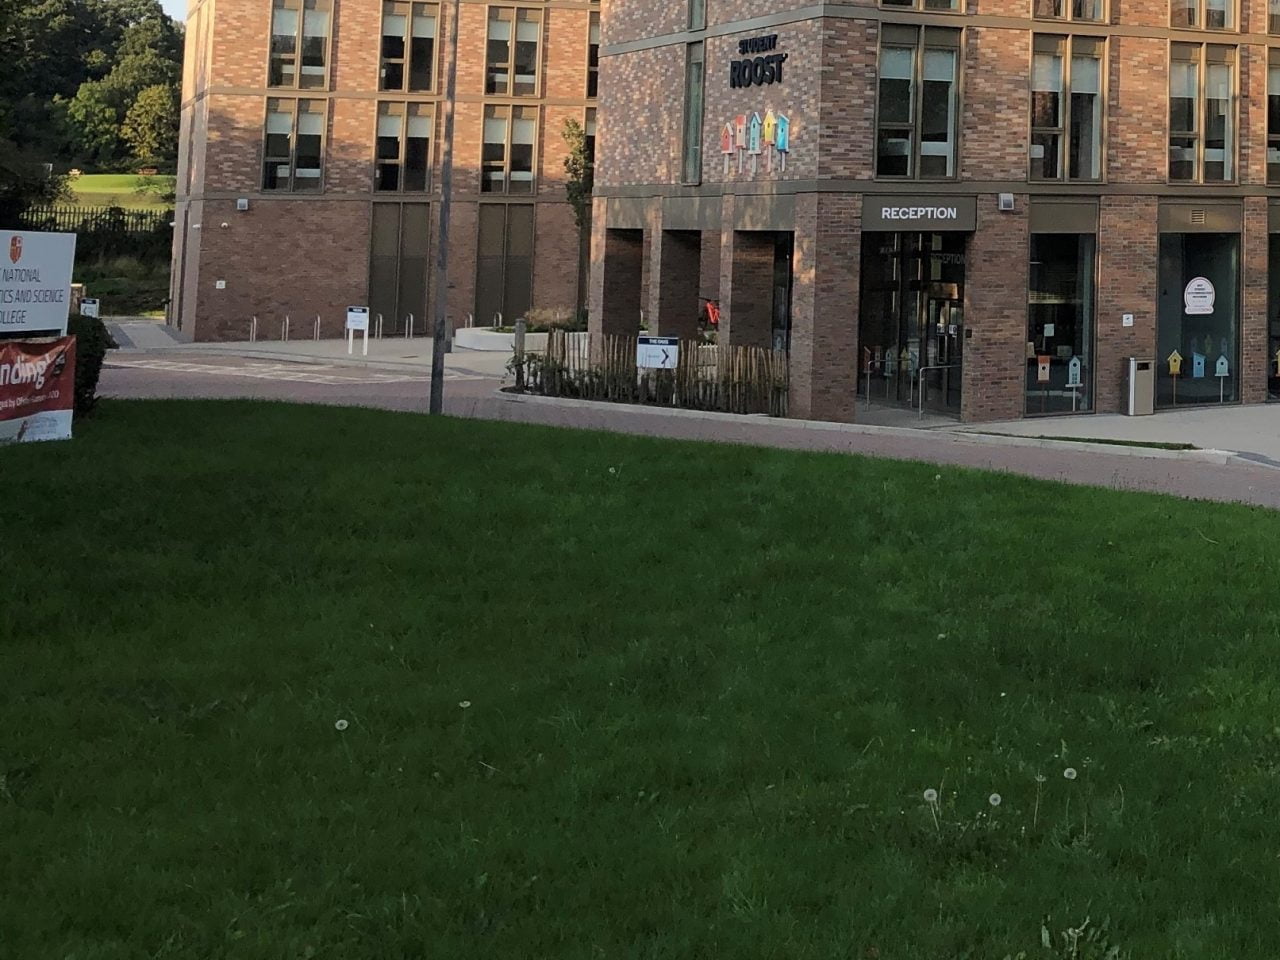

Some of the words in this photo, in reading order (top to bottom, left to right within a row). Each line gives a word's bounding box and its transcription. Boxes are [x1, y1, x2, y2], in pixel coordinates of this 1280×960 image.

[738, 34, 778, 55] STUDENT
[730, 53, 786, 88] ROOST
[881, 207, 957, 219] RECEPTION
[3, 268, 41, 282] NATIONAL
[15, 289, 31, 303] AND
[33, 289, 64, 303] SCIENCE
